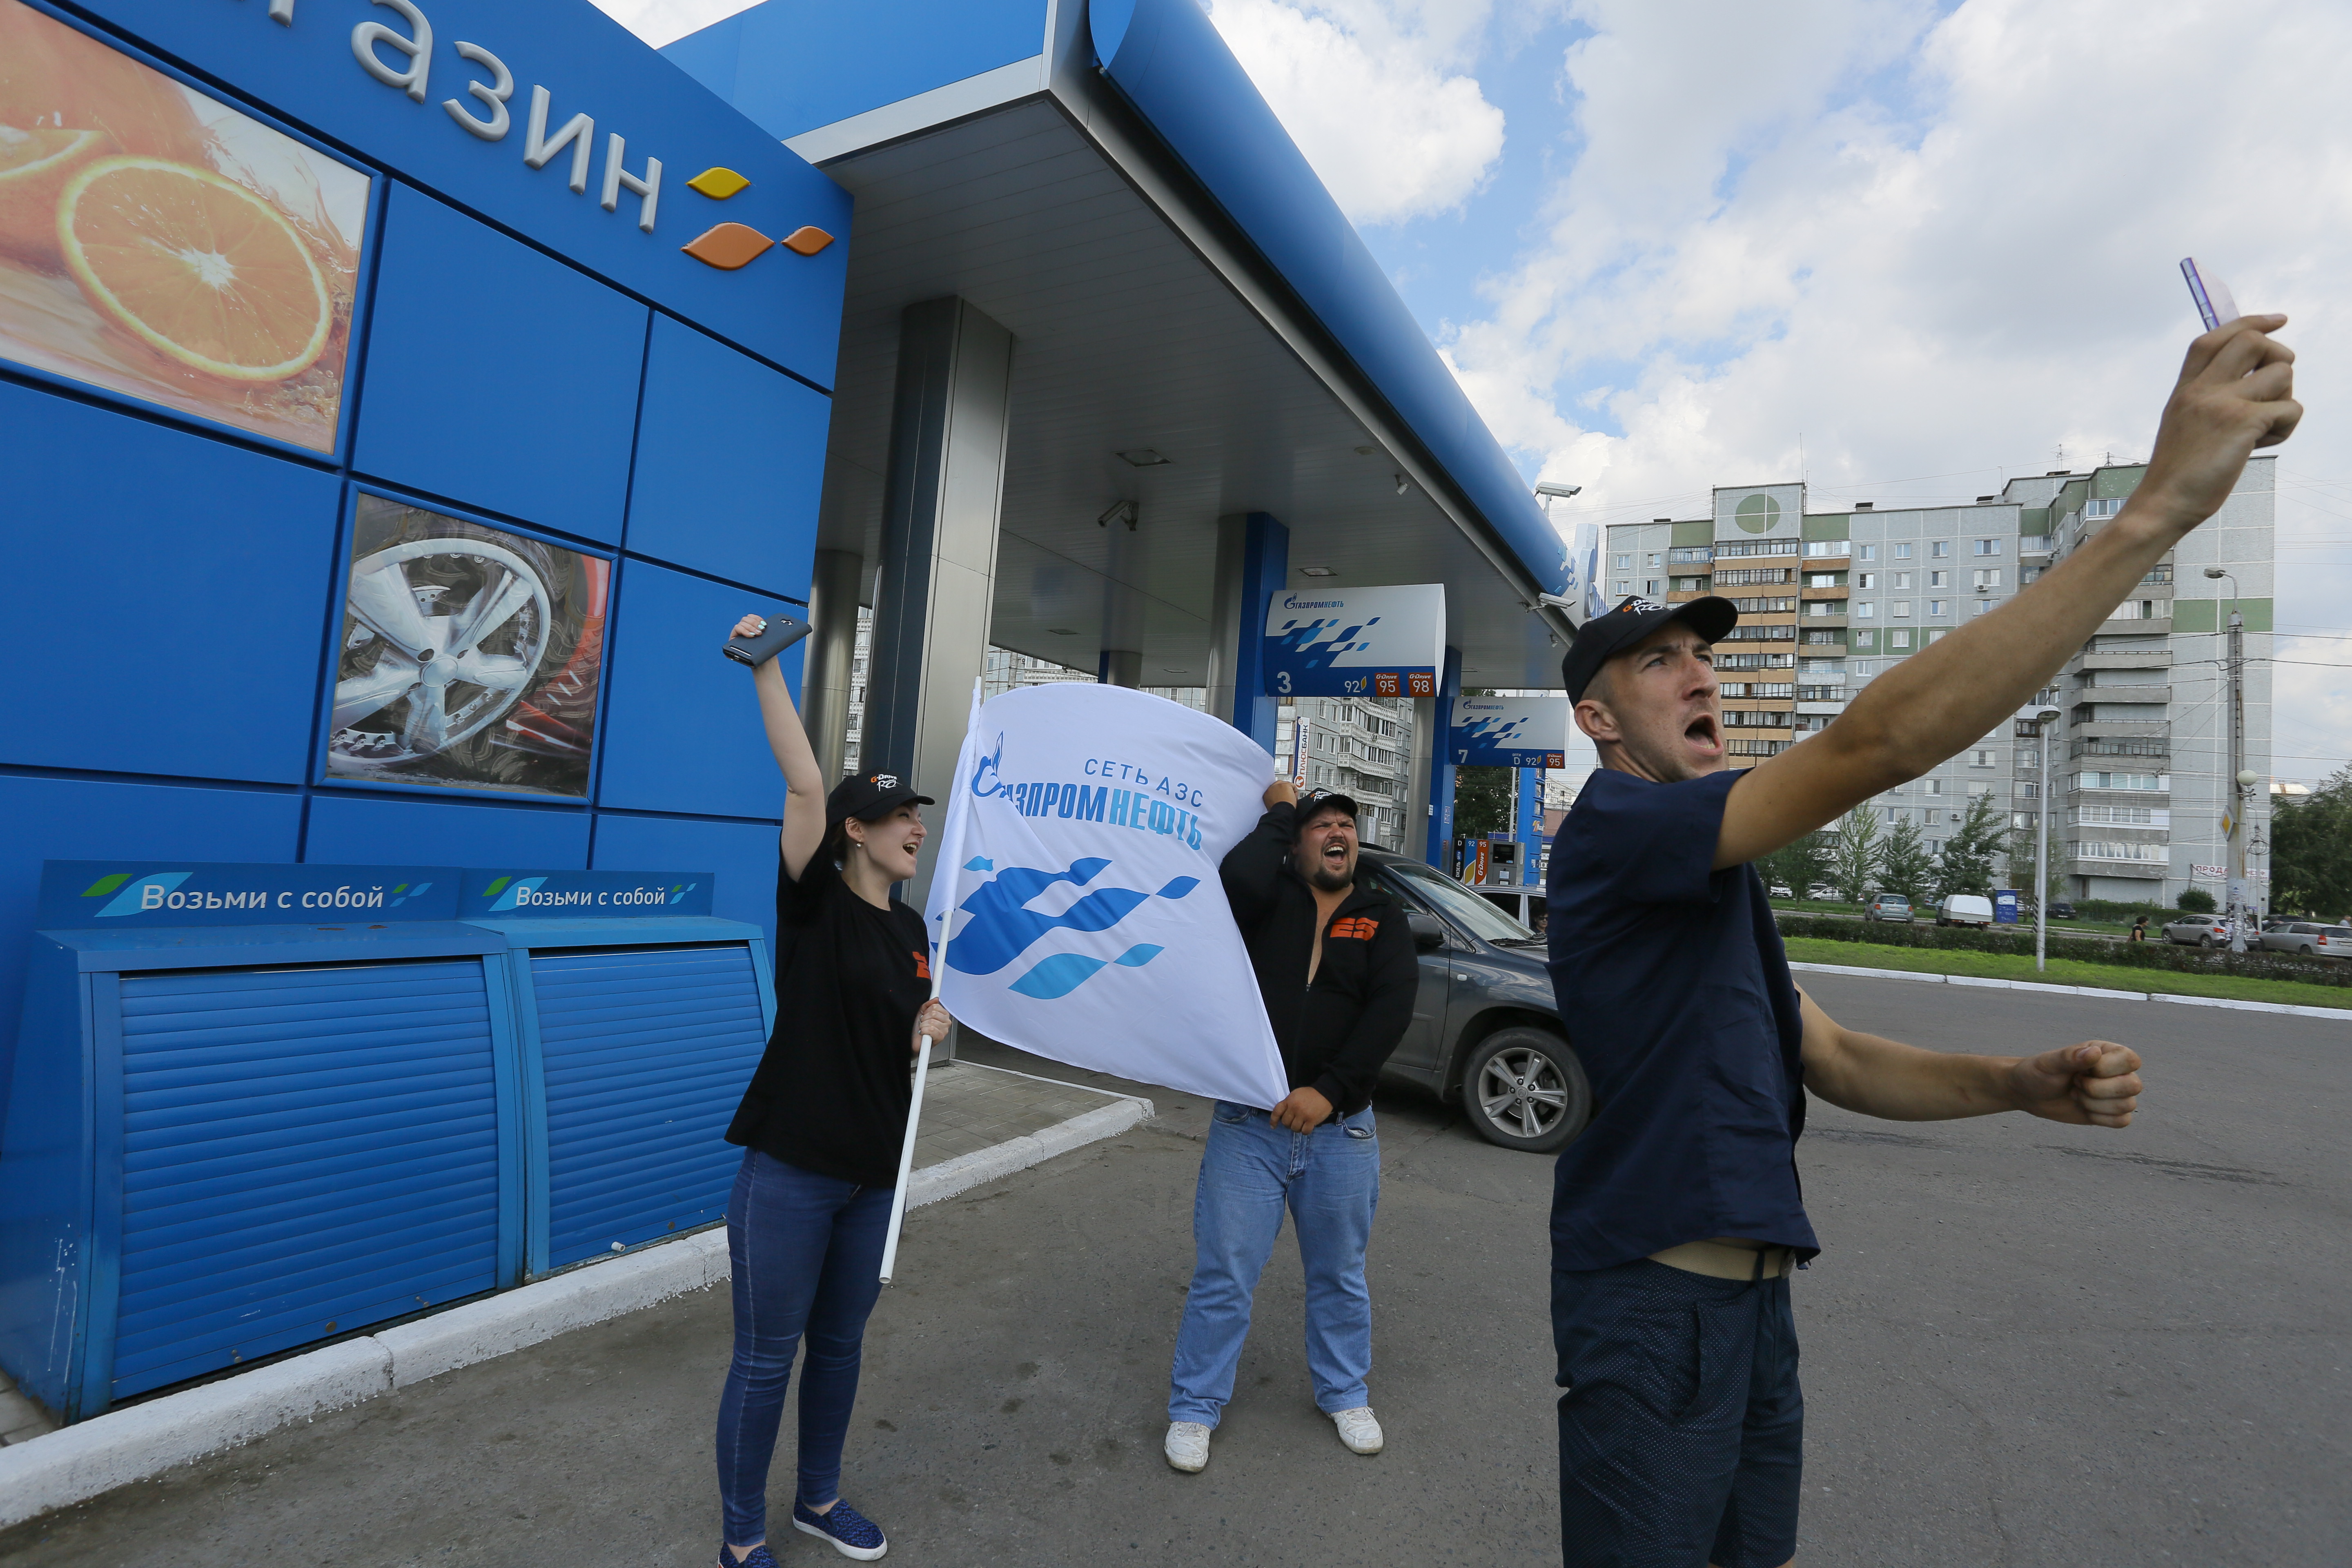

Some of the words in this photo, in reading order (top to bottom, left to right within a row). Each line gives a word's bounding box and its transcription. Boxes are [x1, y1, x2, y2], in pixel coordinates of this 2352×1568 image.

[268, 0, 663, 234] азин
[1295, 601, 1344, 609] ГАЗПРОМНЕФТЬ
[1277, 672, 1292, 693] 3
[1345, 681, 1360, 693] 92
[1379, 680, 1396, 693] 95
[1413, 680, 1430, 693] 98
[1300, 725, 1308, 775] ПЛЮСБАНК
[1458, 750, 1468, 763] 7
[1084, 758, 1149, 785] СЕТЬ
[1156, 776, 1203, 807] АЗС
[141, 884, 267, 909] Возьми
[277, 891, 292, 909] с
[302, 886, 383, 909] собой
[515, 886, 592, 906] Возьми
[598, 892, 608, 906] с
[613, 887, 665, 906] собой
